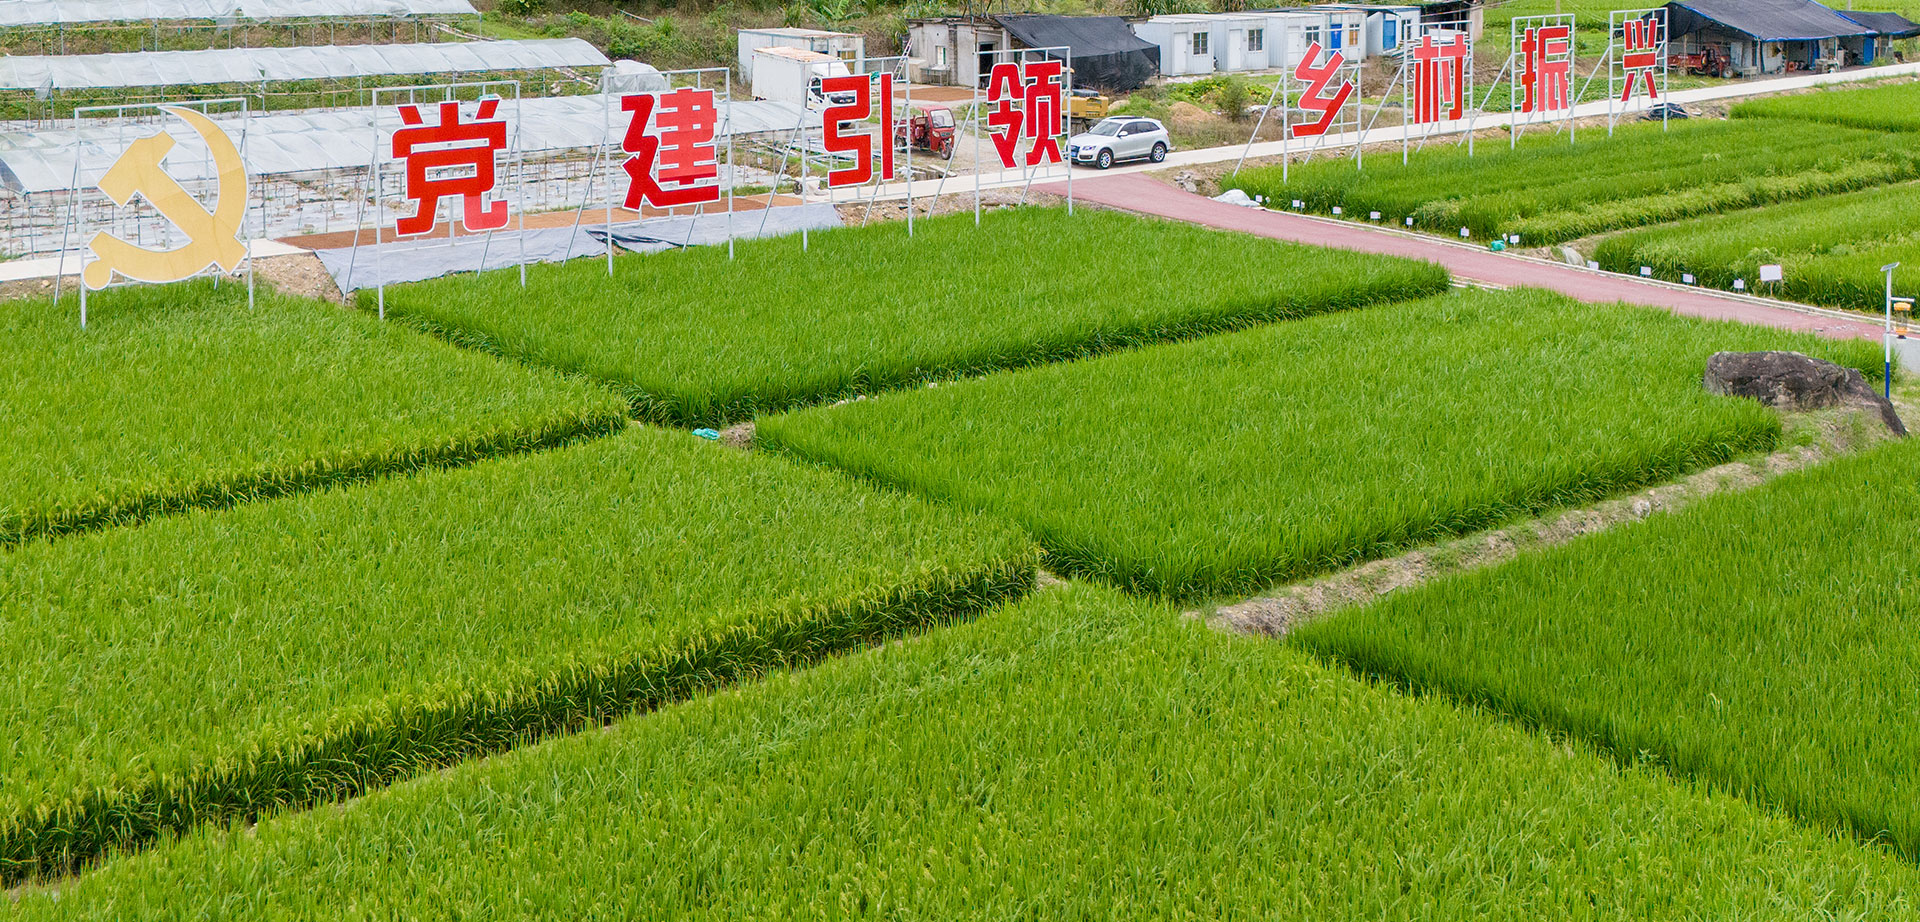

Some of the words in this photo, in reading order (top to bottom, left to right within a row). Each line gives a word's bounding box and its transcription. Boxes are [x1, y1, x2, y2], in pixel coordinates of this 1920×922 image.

[390, 60, 1063, 237] 党建引领
[1290, 18, 1658, 138] 乡村振兴
